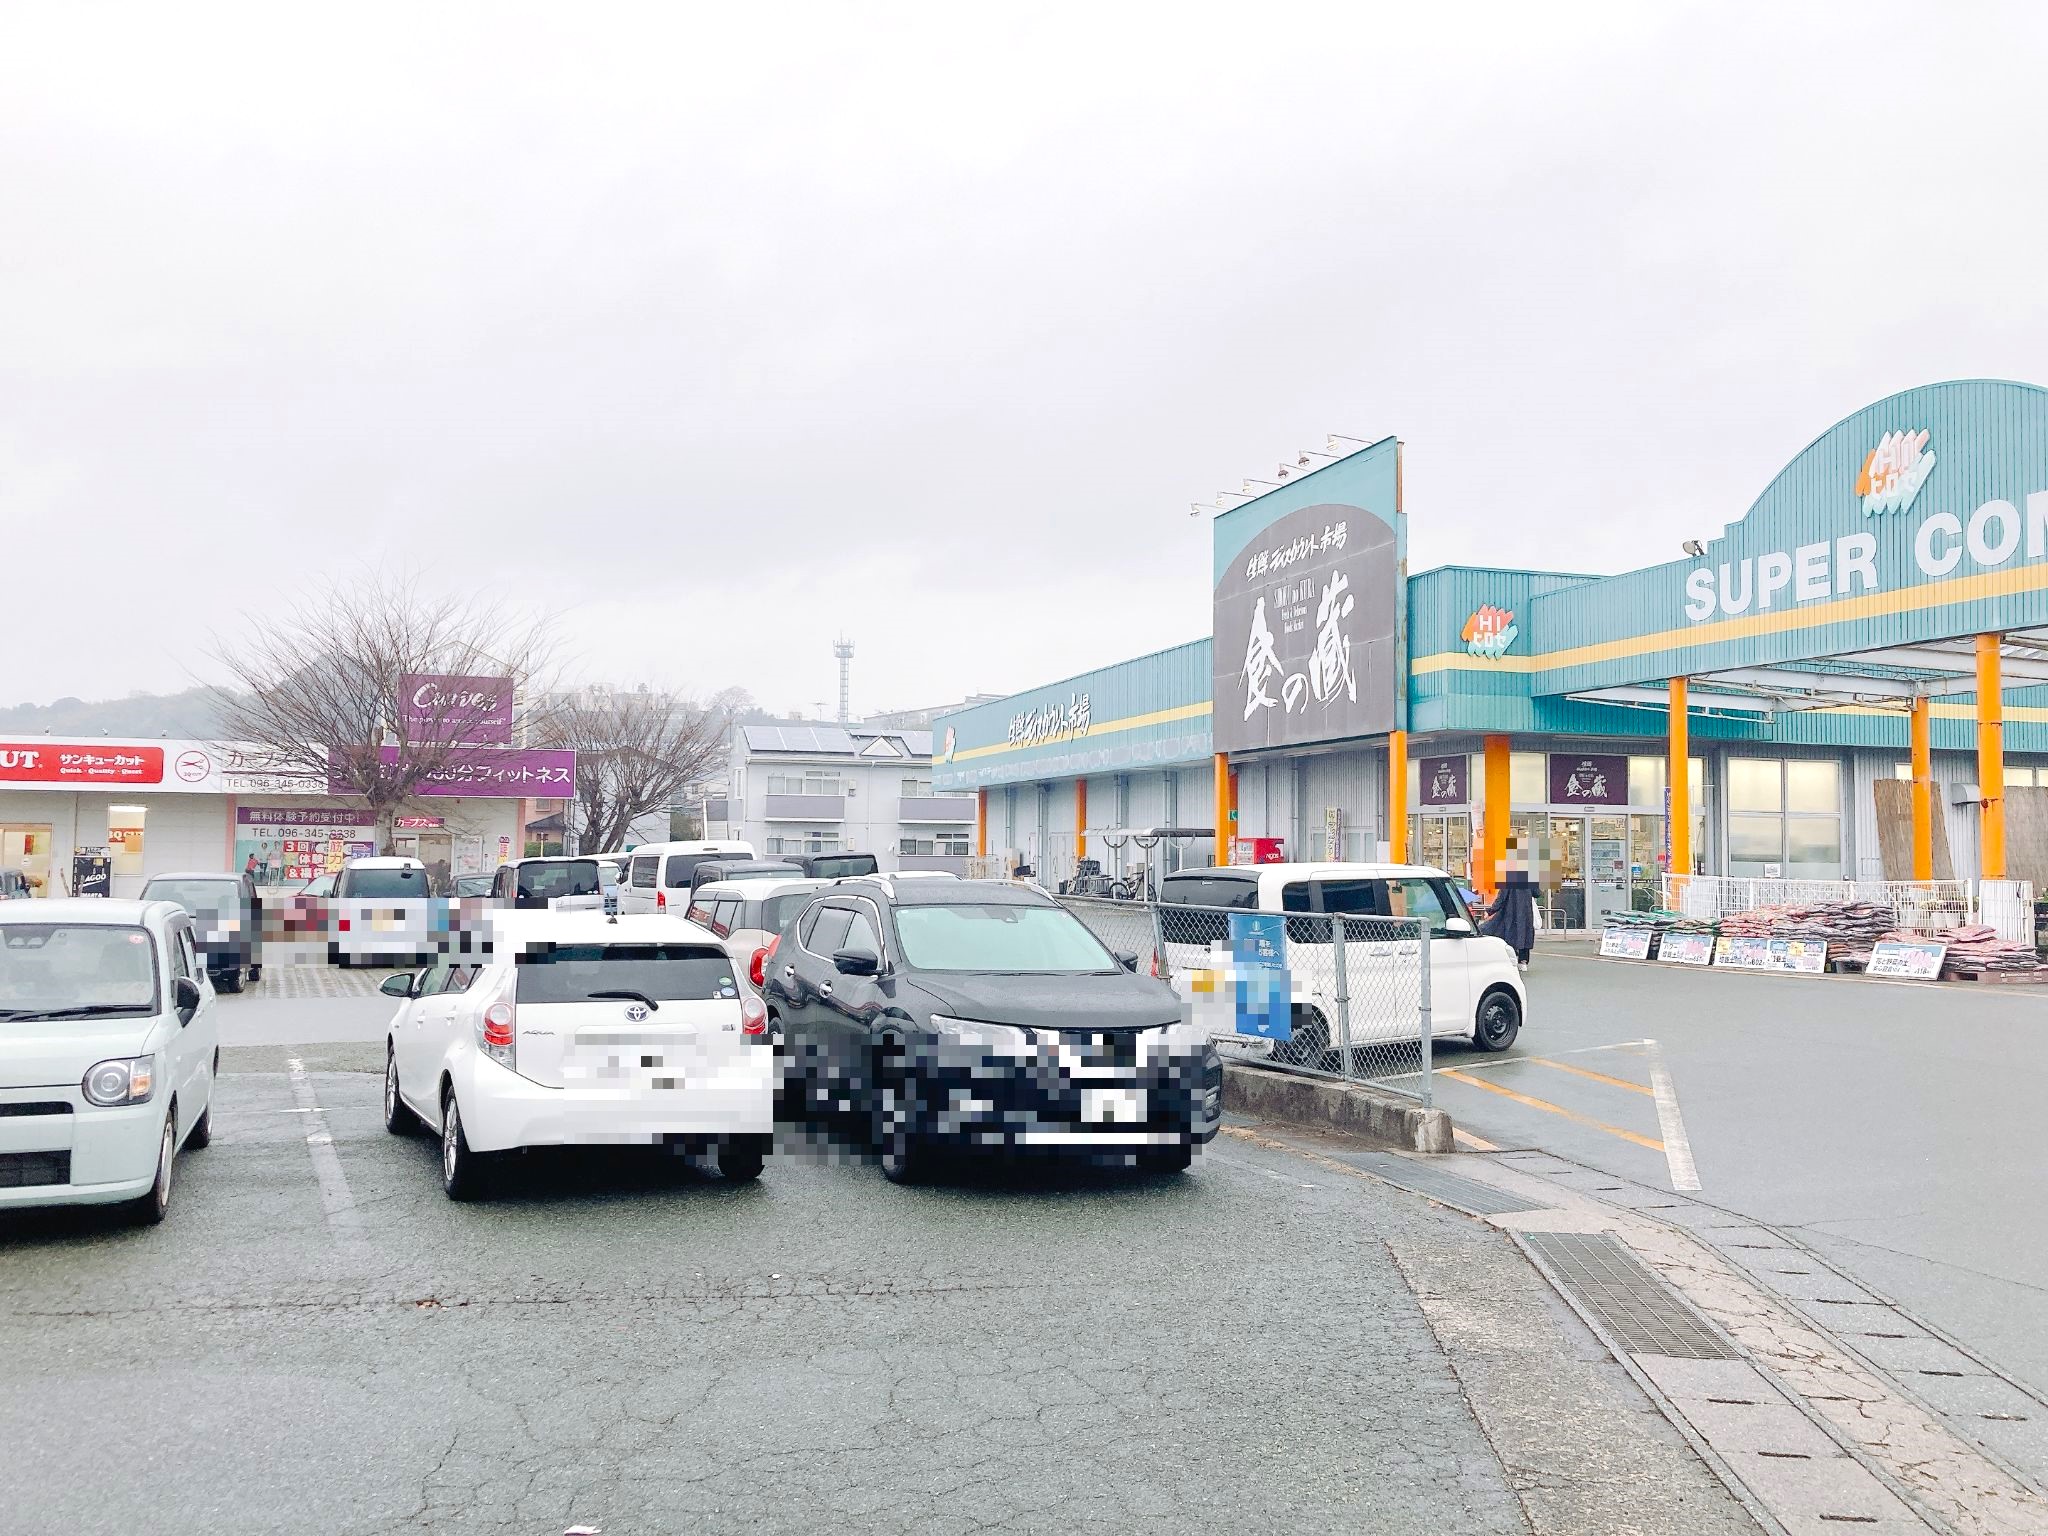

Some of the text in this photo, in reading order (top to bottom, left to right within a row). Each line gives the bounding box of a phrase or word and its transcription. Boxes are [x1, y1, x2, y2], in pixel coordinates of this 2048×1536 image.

[1684, 532, 1879, 622] SUPER
[1480, 615, 1501, 632] HI
[1473, 631, 1507, 649] ヒロセ
[59, 753, 145, 767] サンキューカット
[249, 810, 361, 824] 無料体験予約受付中!
